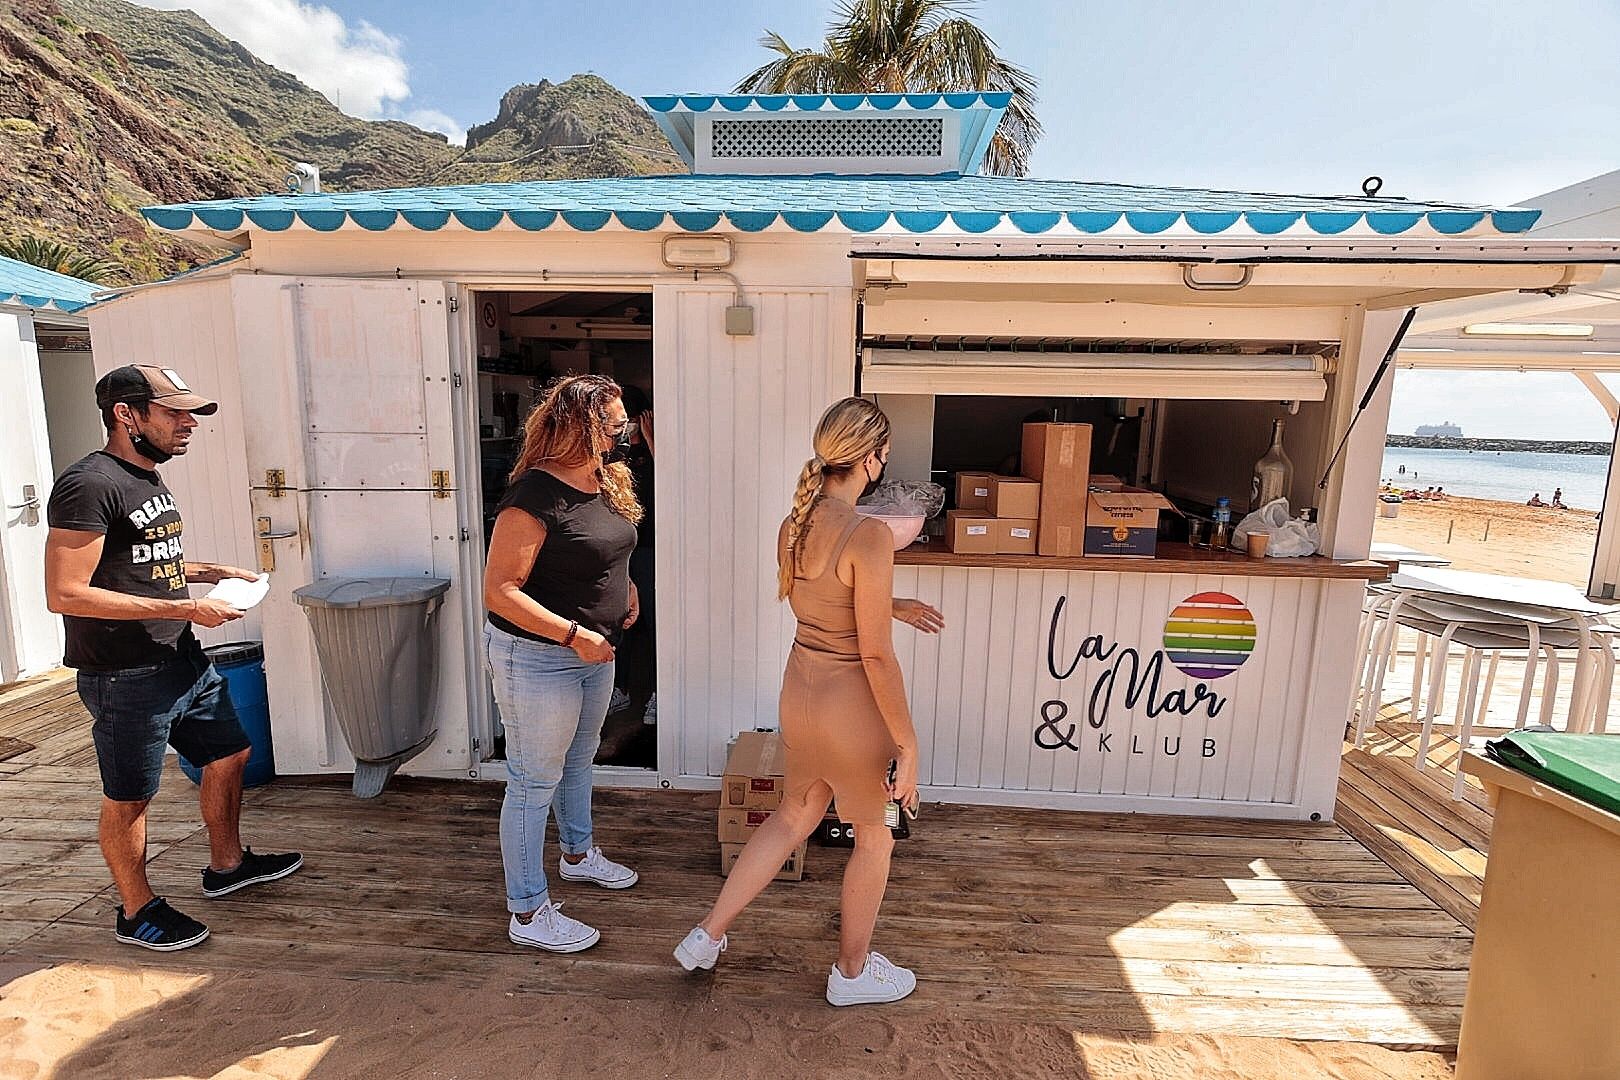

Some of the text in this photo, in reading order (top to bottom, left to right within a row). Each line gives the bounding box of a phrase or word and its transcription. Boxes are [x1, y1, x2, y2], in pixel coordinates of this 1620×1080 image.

[145, 527, 166, 540] IS
[1089, 648, 1227, 729] Mar
[1034, 700, 1217, 758] & KLUB
